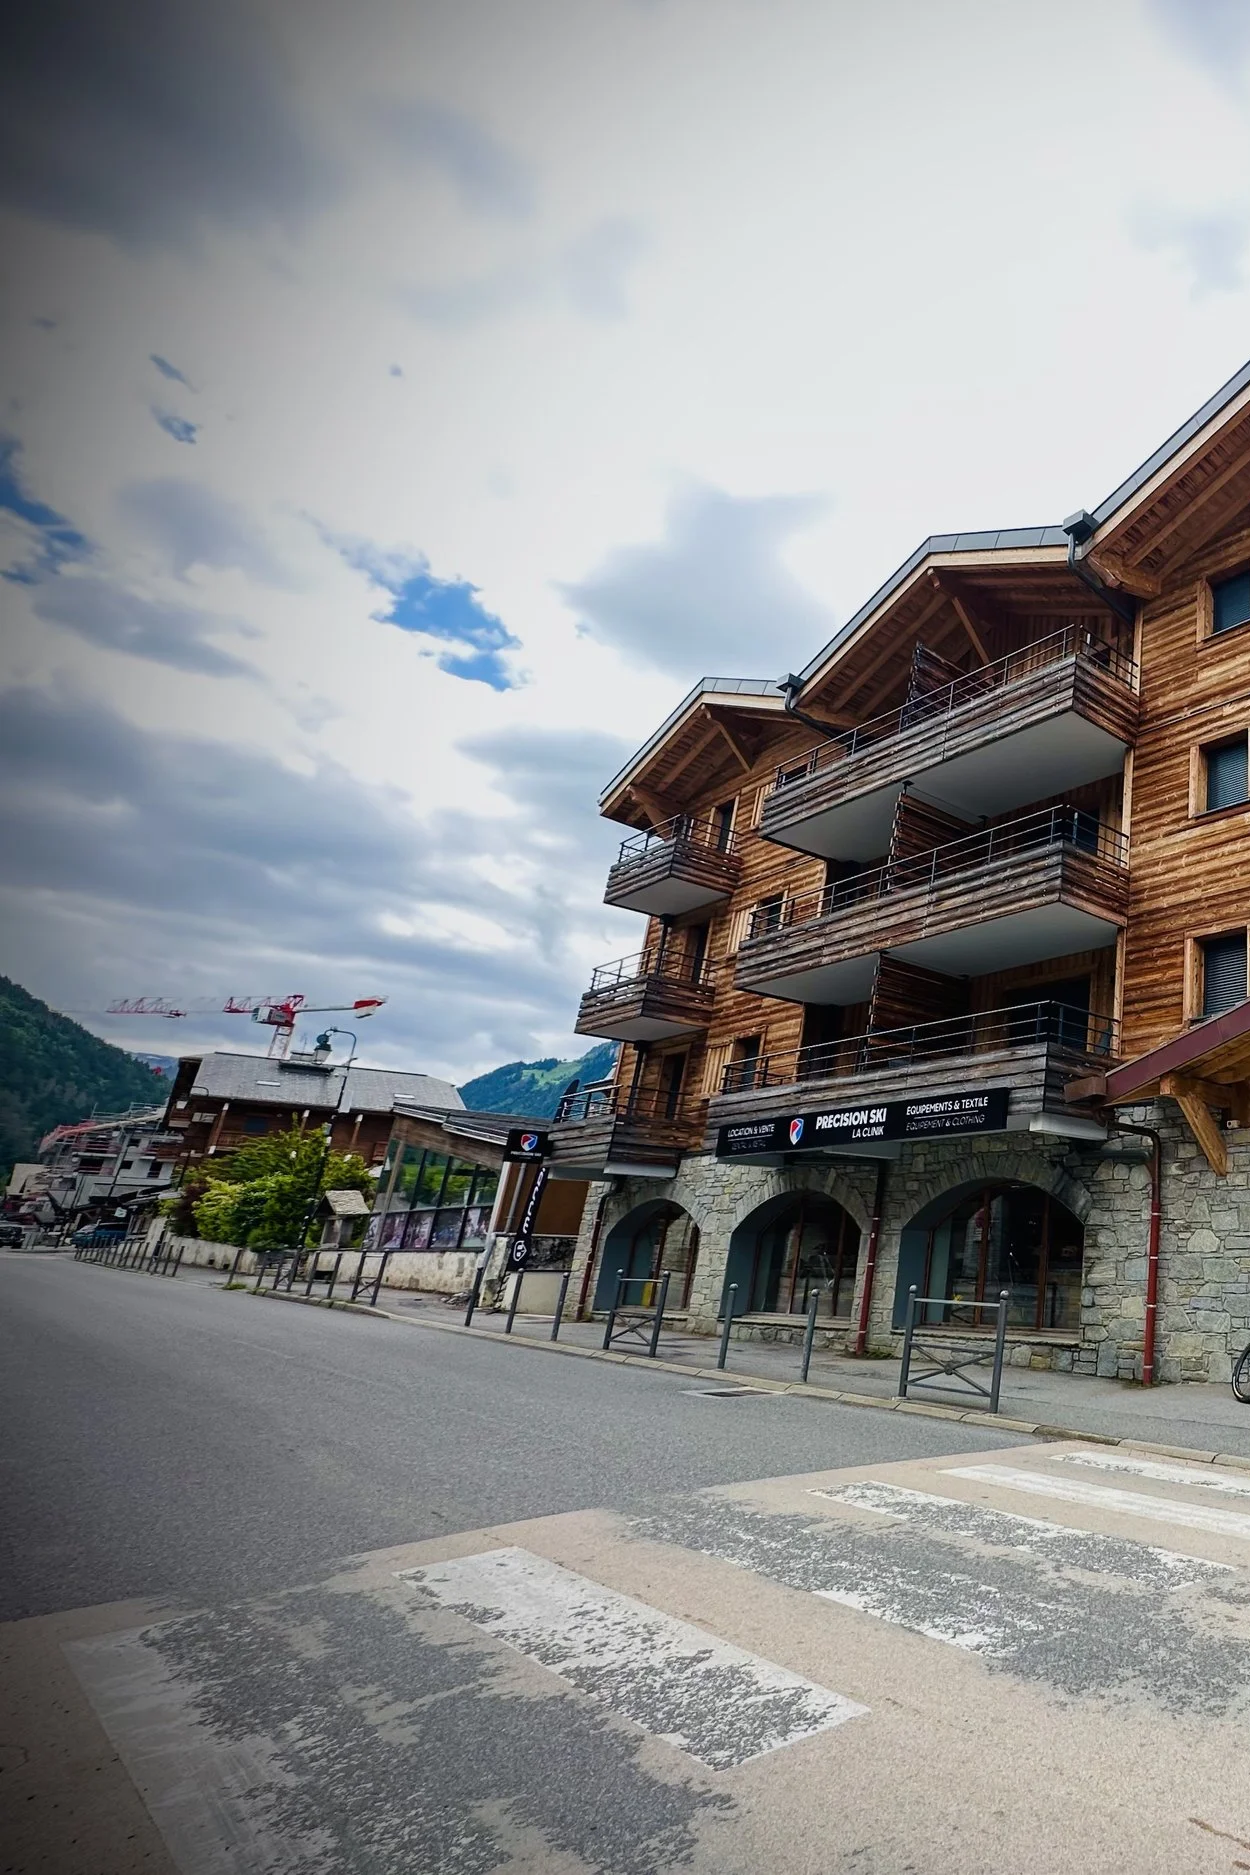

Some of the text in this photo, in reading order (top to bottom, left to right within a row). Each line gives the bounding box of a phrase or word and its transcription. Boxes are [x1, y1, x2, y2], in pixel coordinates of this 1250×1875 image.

[906, 1096, 989, 1115] EQUIPEMENTS & TEXTILE
[815, 1107, 888, 1130] PRECISION SKI
[951, 1114, 985, 1127] CLOTHING
[727, 1127, 753, 1138] LOCATION
[758, 1123, 776, 1134] VENTE
[851, 1125, 885, 1138] LA CLINIK
